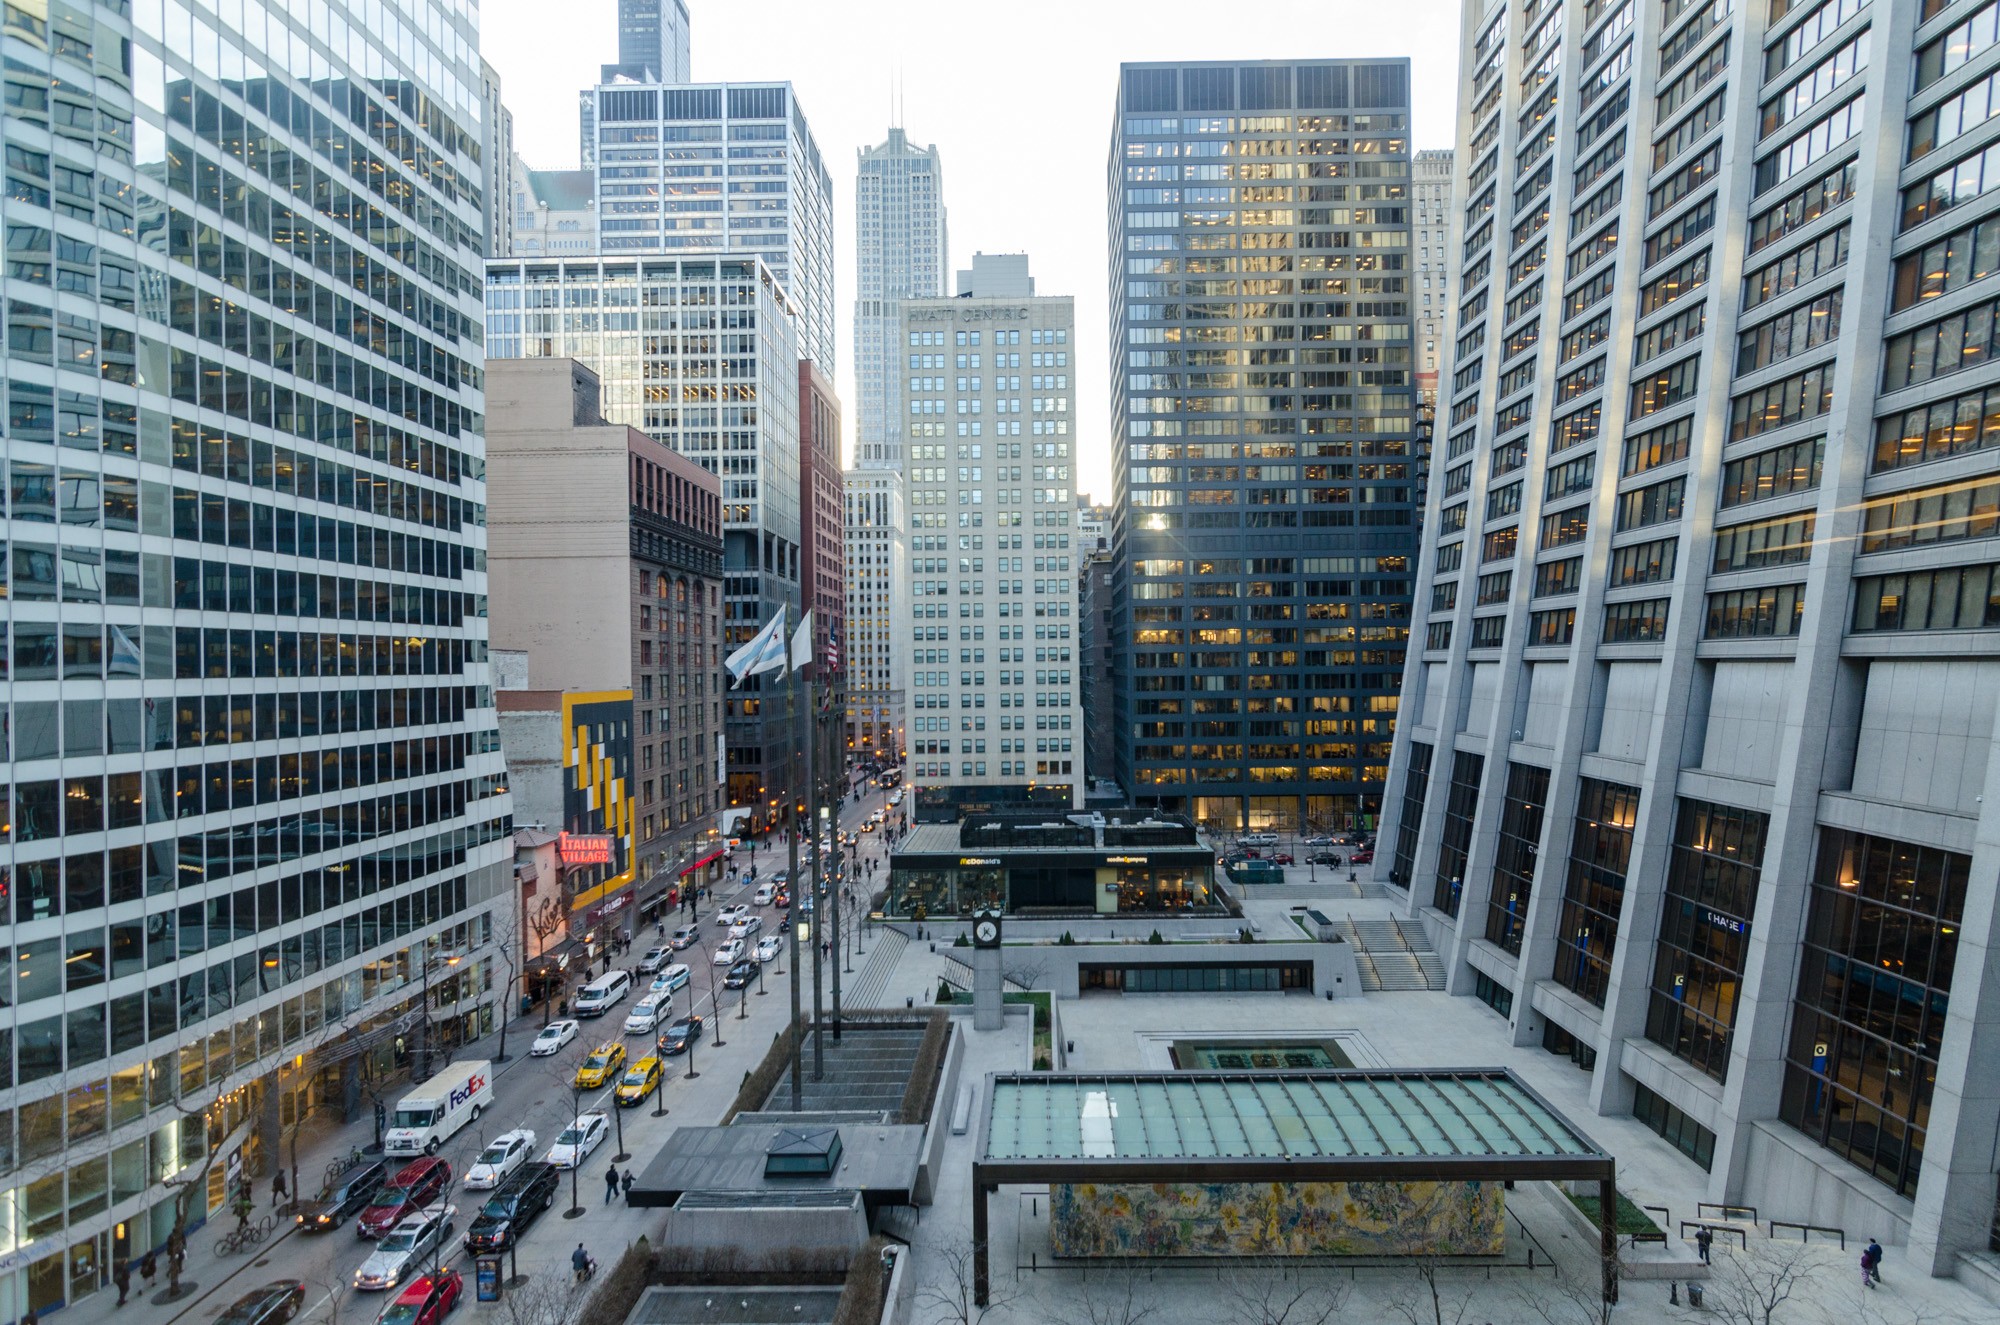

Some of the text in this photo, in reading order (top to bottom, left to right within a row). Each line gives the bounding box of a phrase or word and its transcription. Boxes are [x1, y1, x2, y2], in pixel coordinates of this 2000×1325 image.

[909, 308, 1028, 322] HYATT CENTRIC
[559, 831, 608, 850] ITALIAN
[560, 851, 609, 862] VILLAGE
[960, 857, 1001, 865] McDonald's
[1707, 912, 1740, 932] CHASE
[450, 1074, 486, 1110] FedEx
